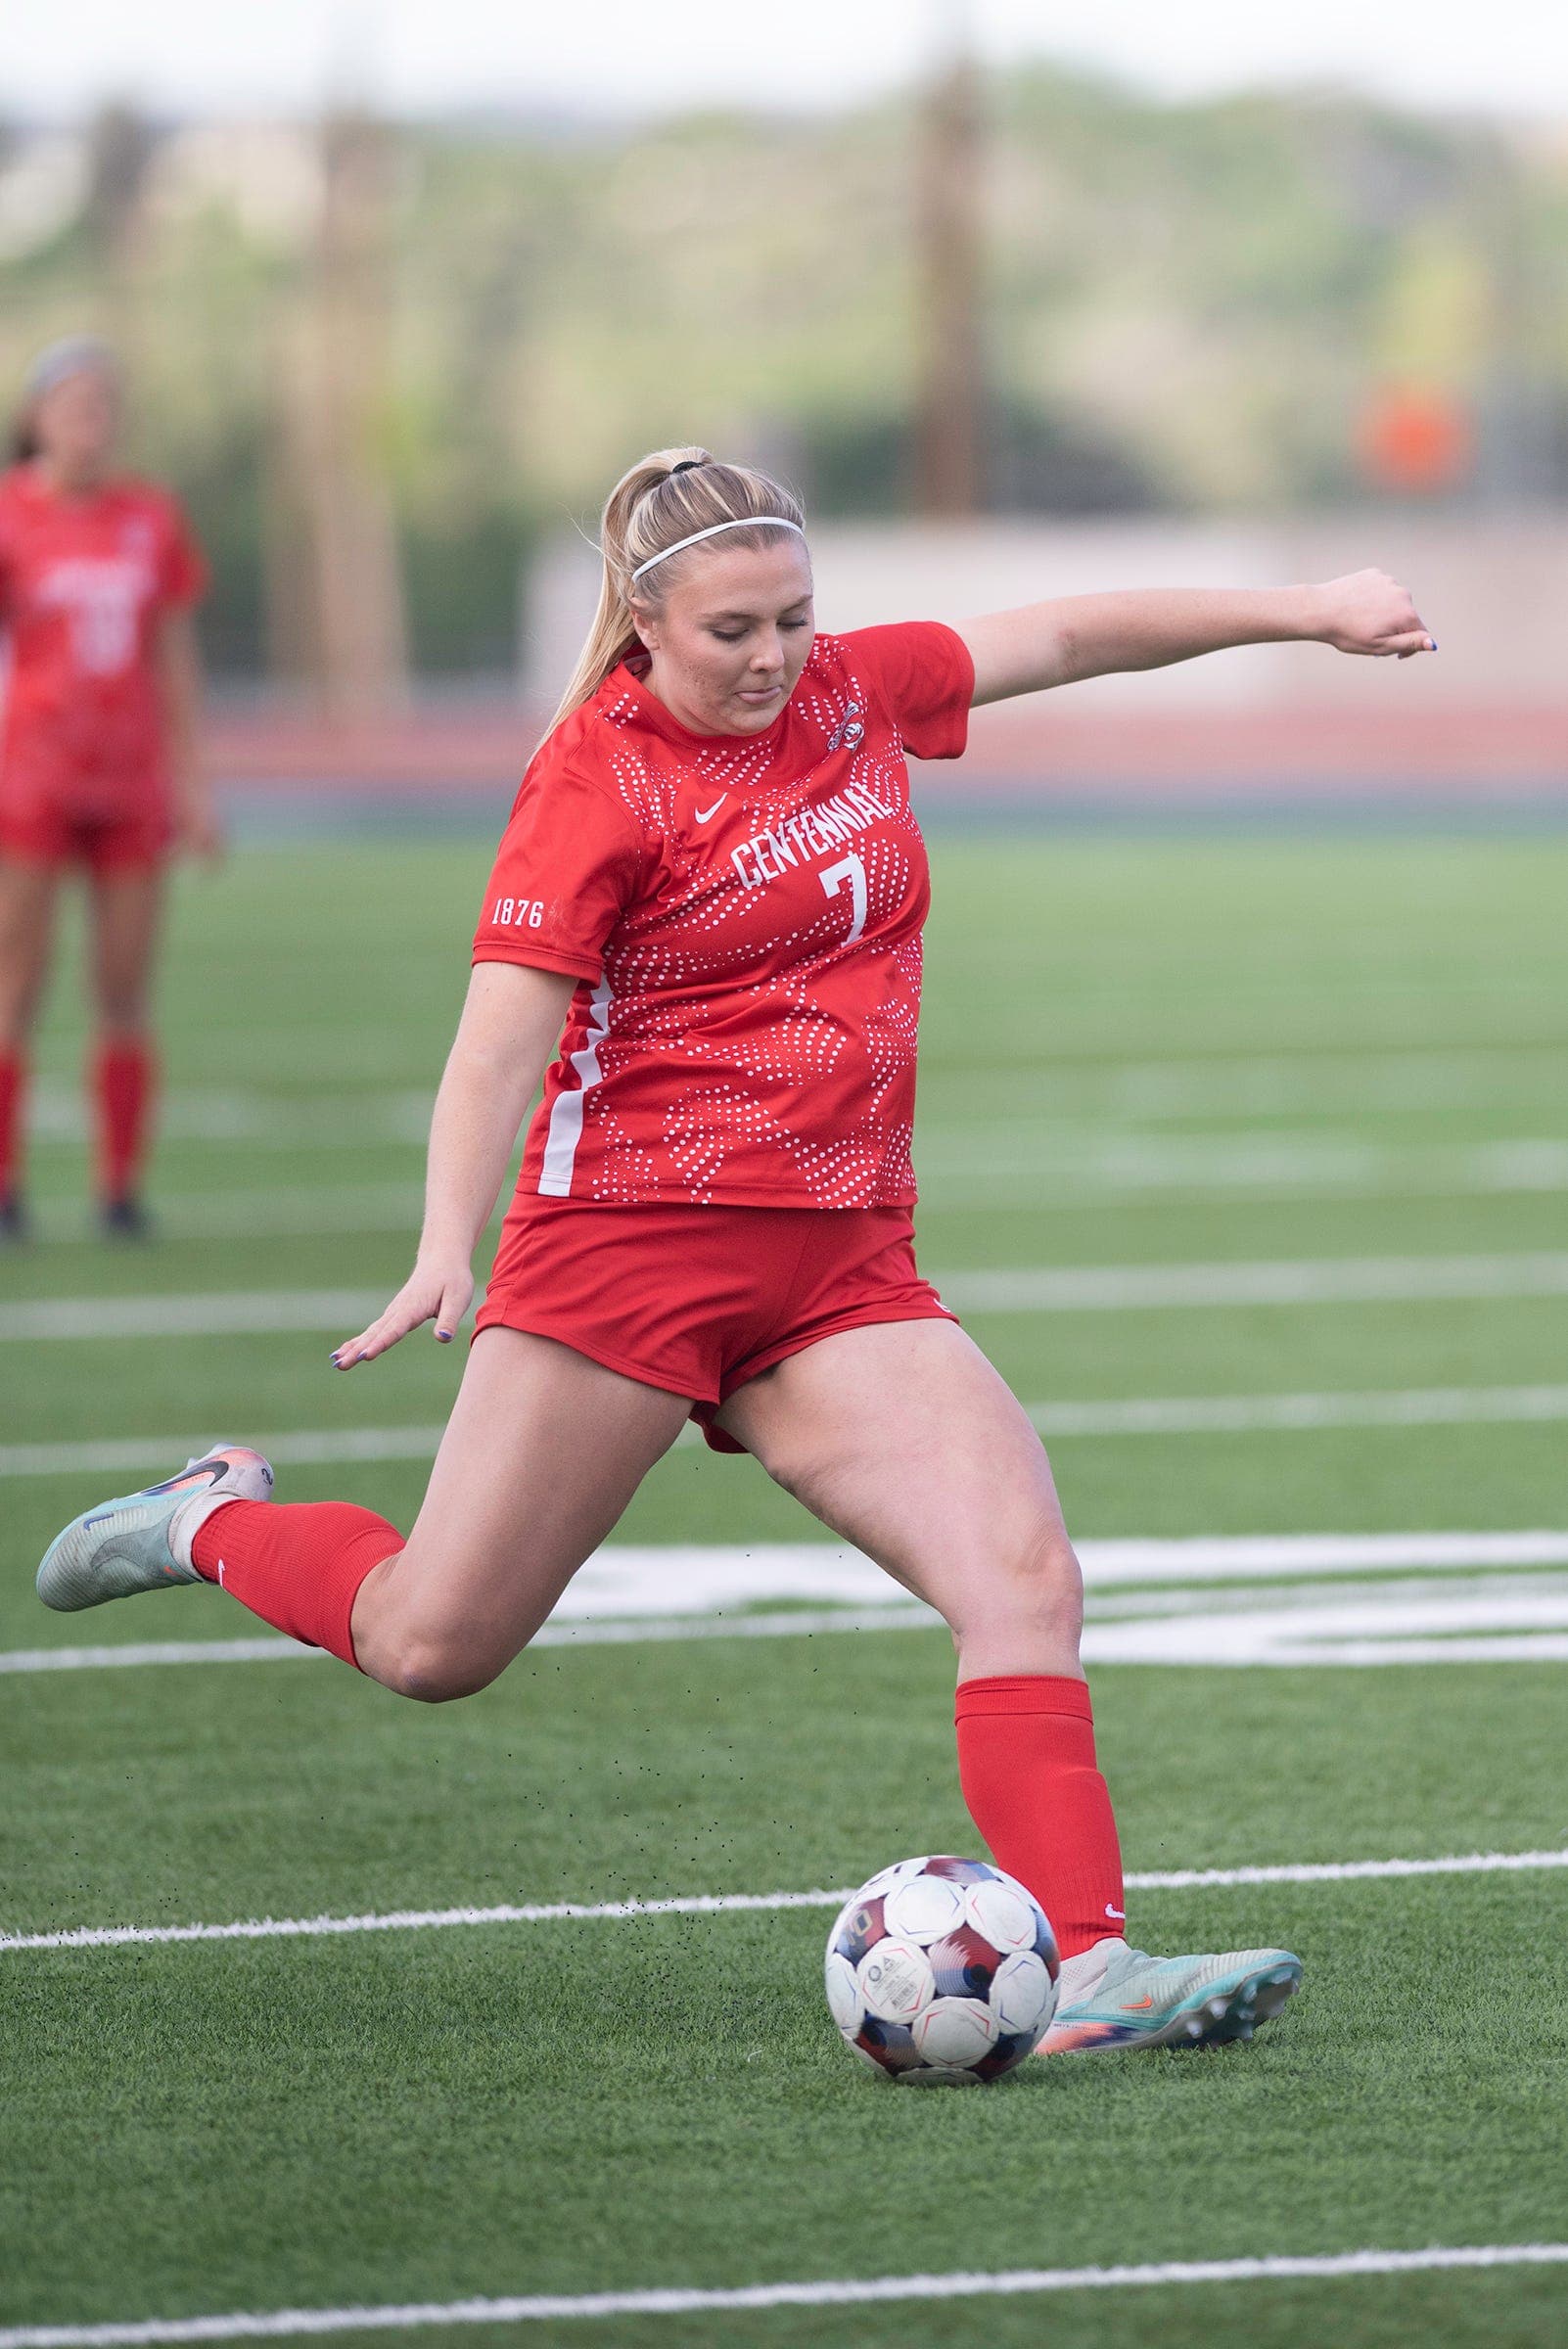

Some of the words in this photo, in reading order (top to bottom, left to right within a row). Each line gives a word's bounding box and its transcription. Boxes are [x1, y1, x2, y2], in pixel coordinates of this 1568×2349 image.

[730, 782, 895, 890] CENTENNIAL
[491, 898, 545, 929] 1876
[818, 852, 868, 948] 7
